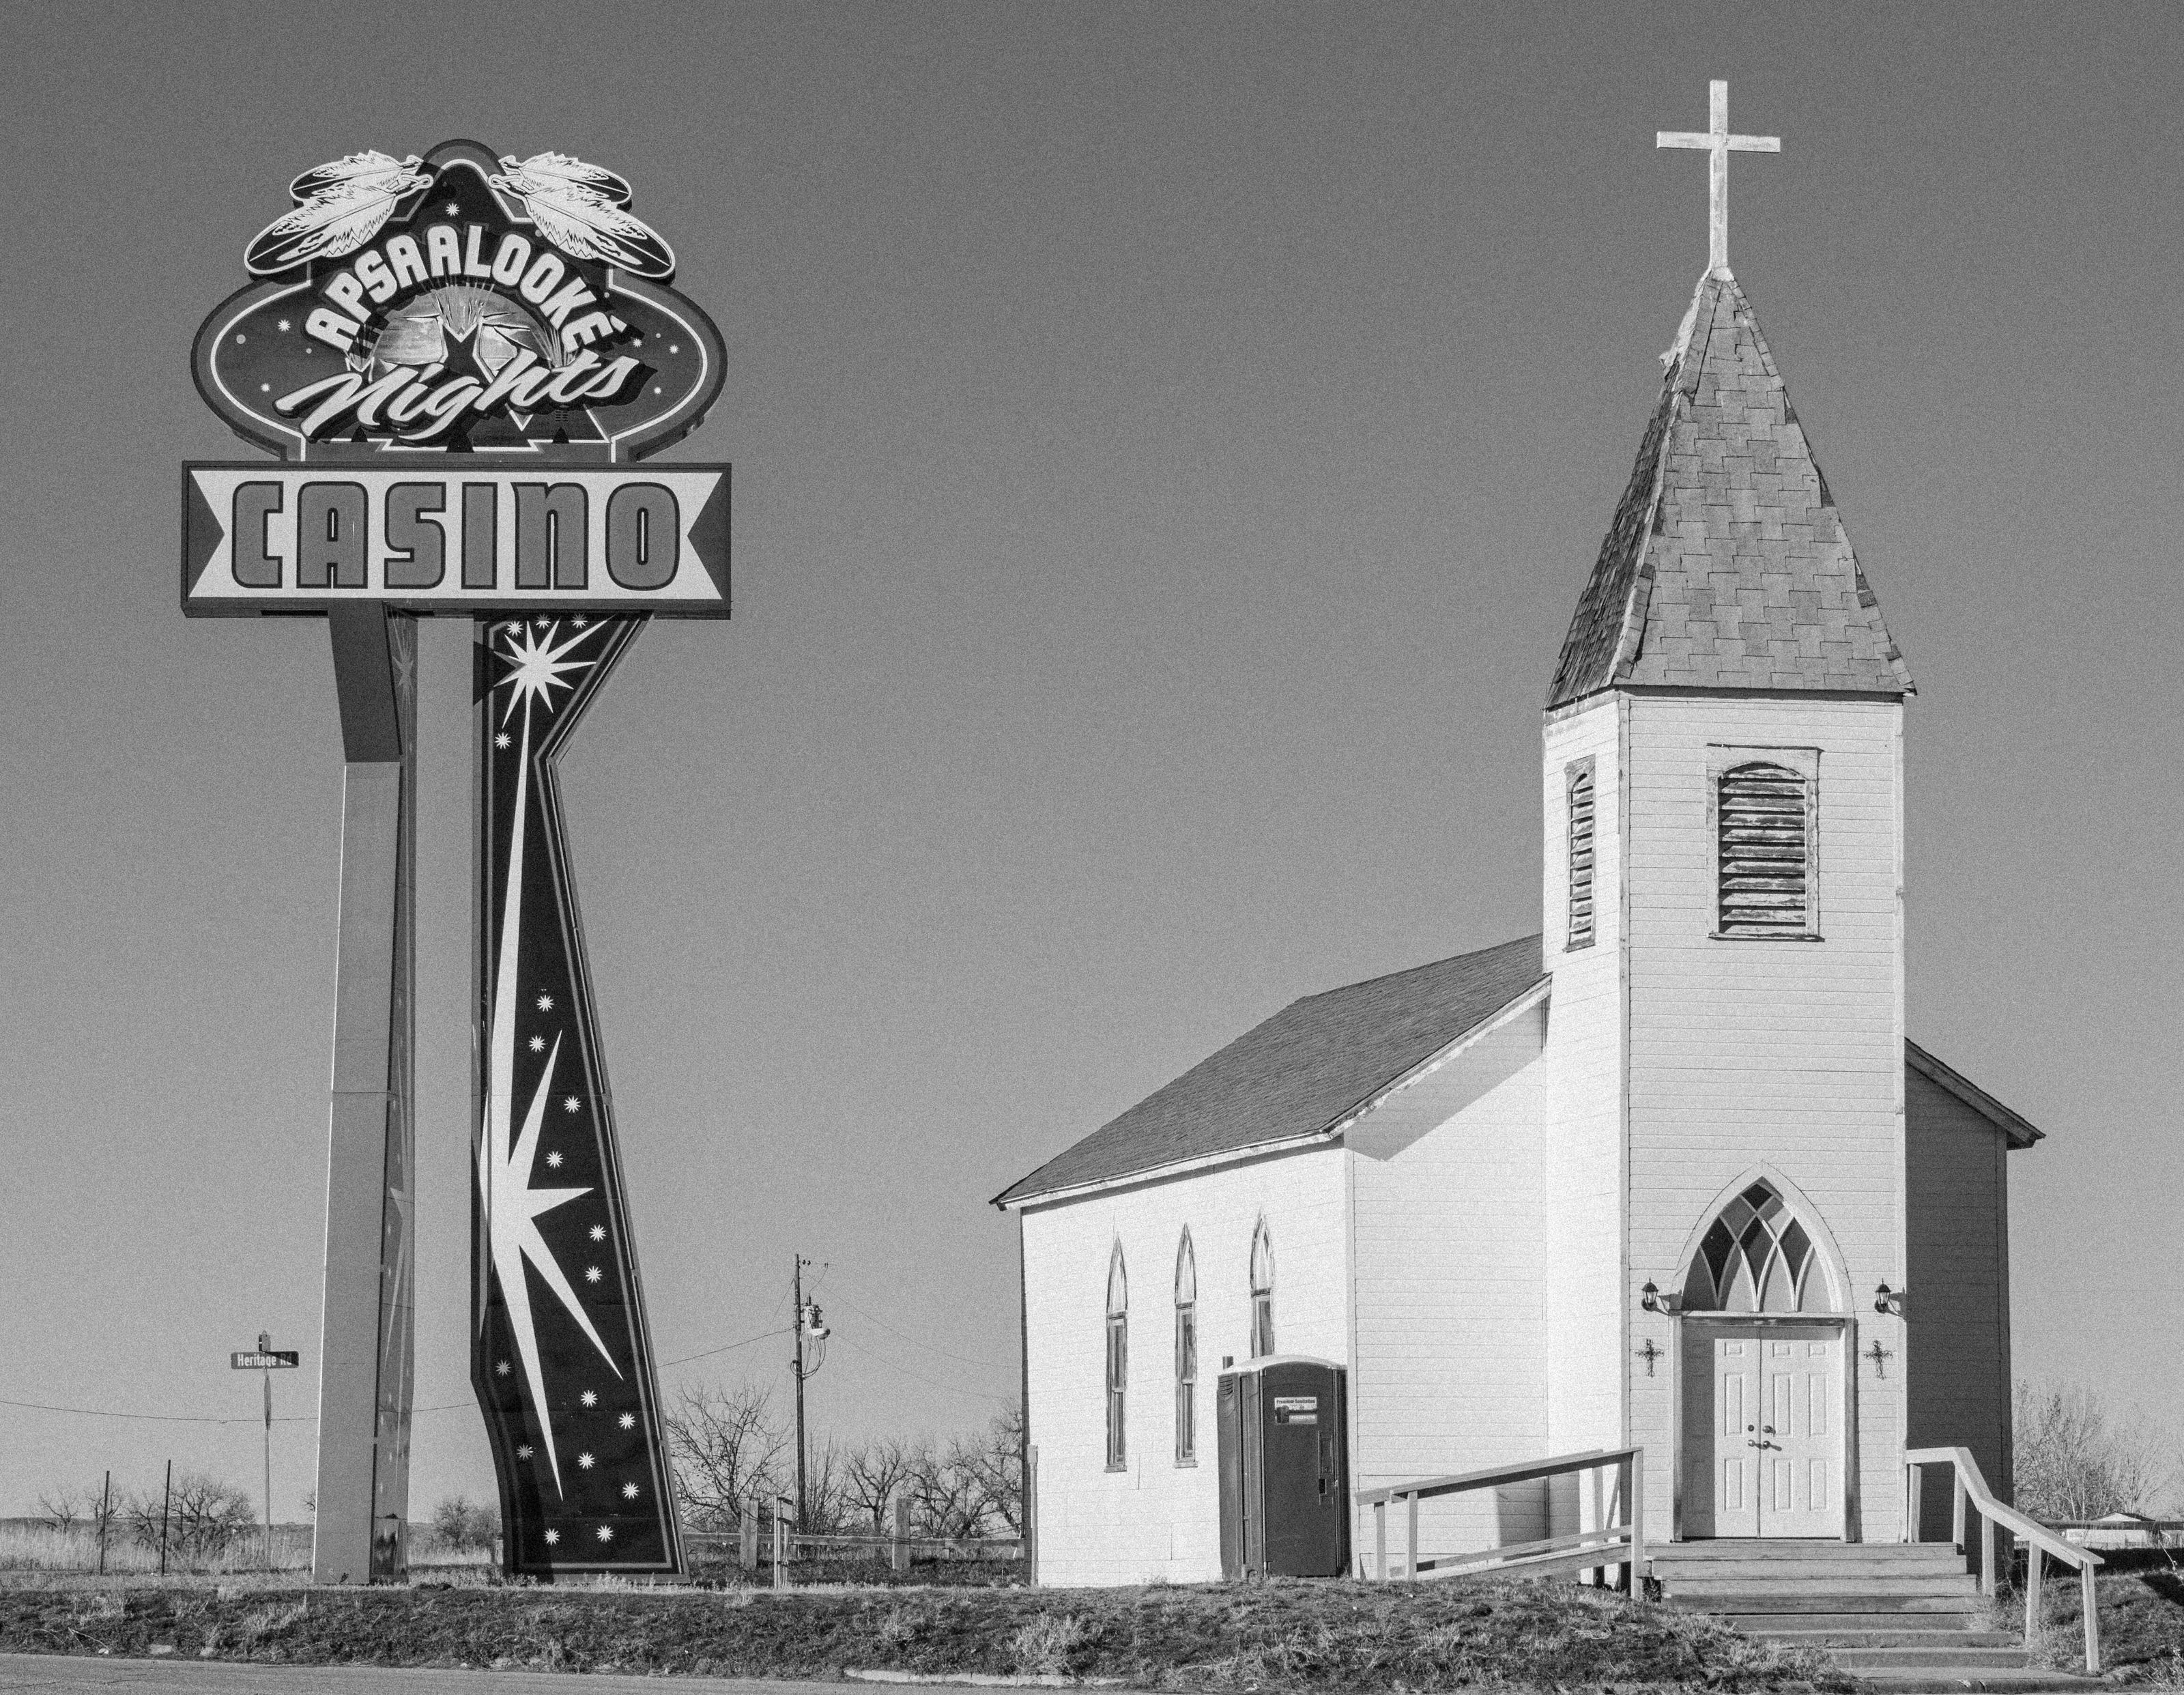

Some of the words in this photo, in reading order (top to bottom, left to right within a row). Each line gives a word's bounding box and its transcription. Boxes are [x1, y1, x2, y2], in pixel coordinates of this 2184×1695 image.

[274, 348, 640, 440] Nights
[231, 481, 681, 590] CASINO
[237, 1354, 277, 1367] Heritage
[280, 1354, 292, 1365] Rd
